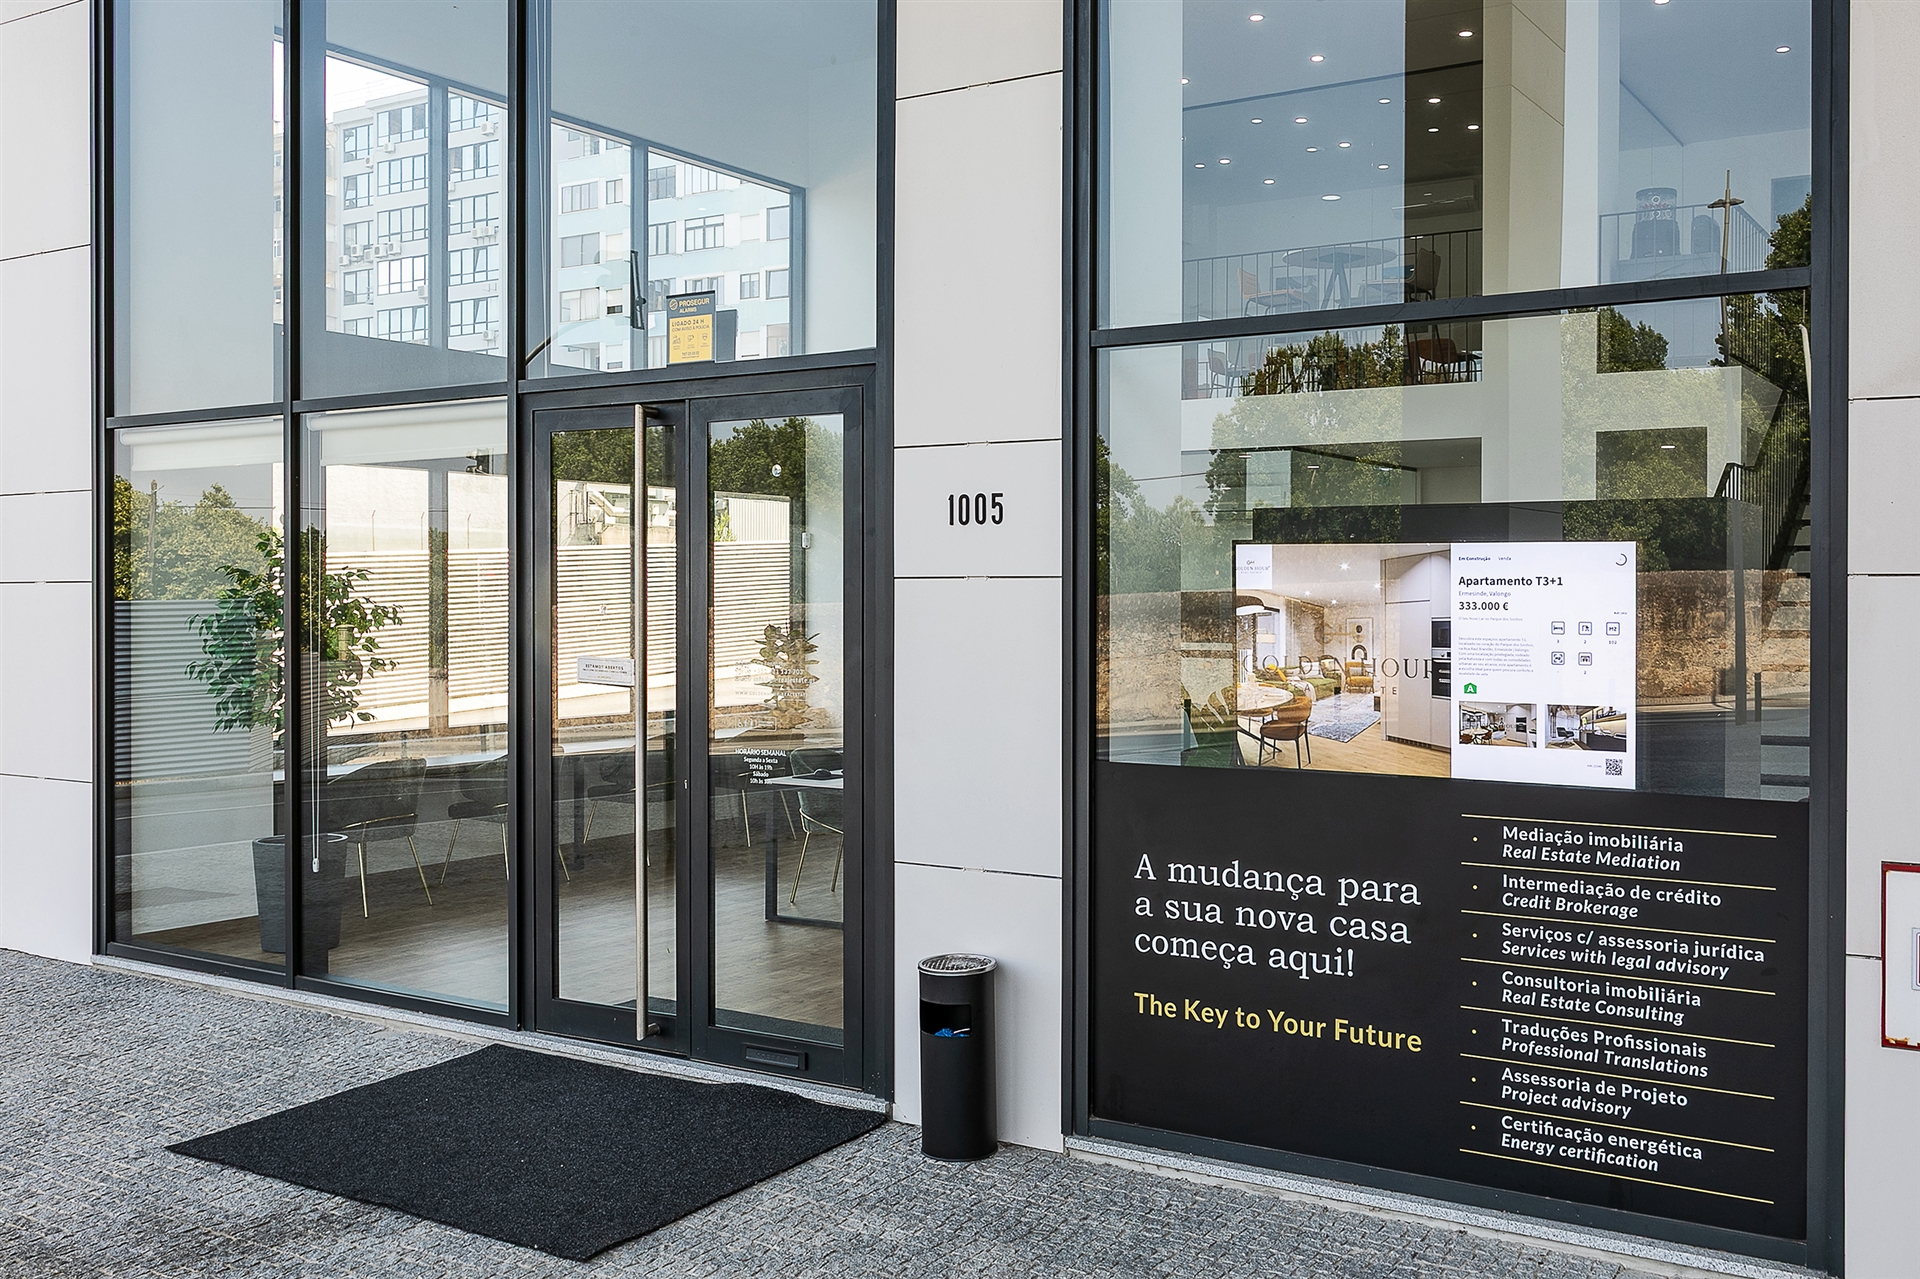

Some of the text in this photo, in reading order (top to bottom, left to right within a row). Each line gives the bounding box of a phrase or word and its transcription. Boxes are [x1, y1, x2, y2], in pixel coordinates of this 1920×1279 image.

[679, 298, 710, 307] PROSEGUR
[948, 493, 1003, 525] 1005
[1458, 576, 1564, 588] Apartamento T3+1
[1458, 601, 1509, 611] 333.000 €
[735, 748, 786, 757] HORÁRIO SEMANAL
[1502, 825, 1684, 853] Mediação imobiliária
[1502, 843, 1681, 872] Real Estate Mediation
[1133, 853, 1422, 907] A mudança para
[1502, 873, 1722, 907] Intermediação de crédito
[1134, 896, 1412, 945] a sua nova casa
[1502, 892, 1639, 920] Credit Brokerage
[1134, 933, 1354, 980] começa aqui!
[1501, 922, 1765, 963] Serviços c/ assessoria jurídica
[1501, 940, 1730, 981] Services with legal advisory
[1501, 970, 1701, 1007] Consultoria imobiliária
[1501, 988, 1685, 1027] Real Estate Consulting
[1133, 991, 1422, 1052] The Key to Your Future
[1501, 1018, 1707, 1059] Traduções Profissionais
[1501, 1036, 1709, 1078] Professional Translations
[1501, 1067, 1688, 1107] Assessoria de Projeto
[1501, 1084, 1632, 1120] Project advisory
[1501, 1115, 1703, 1160] Certificação energética
[1501, 1132, 1659, 1172] Energy certification
